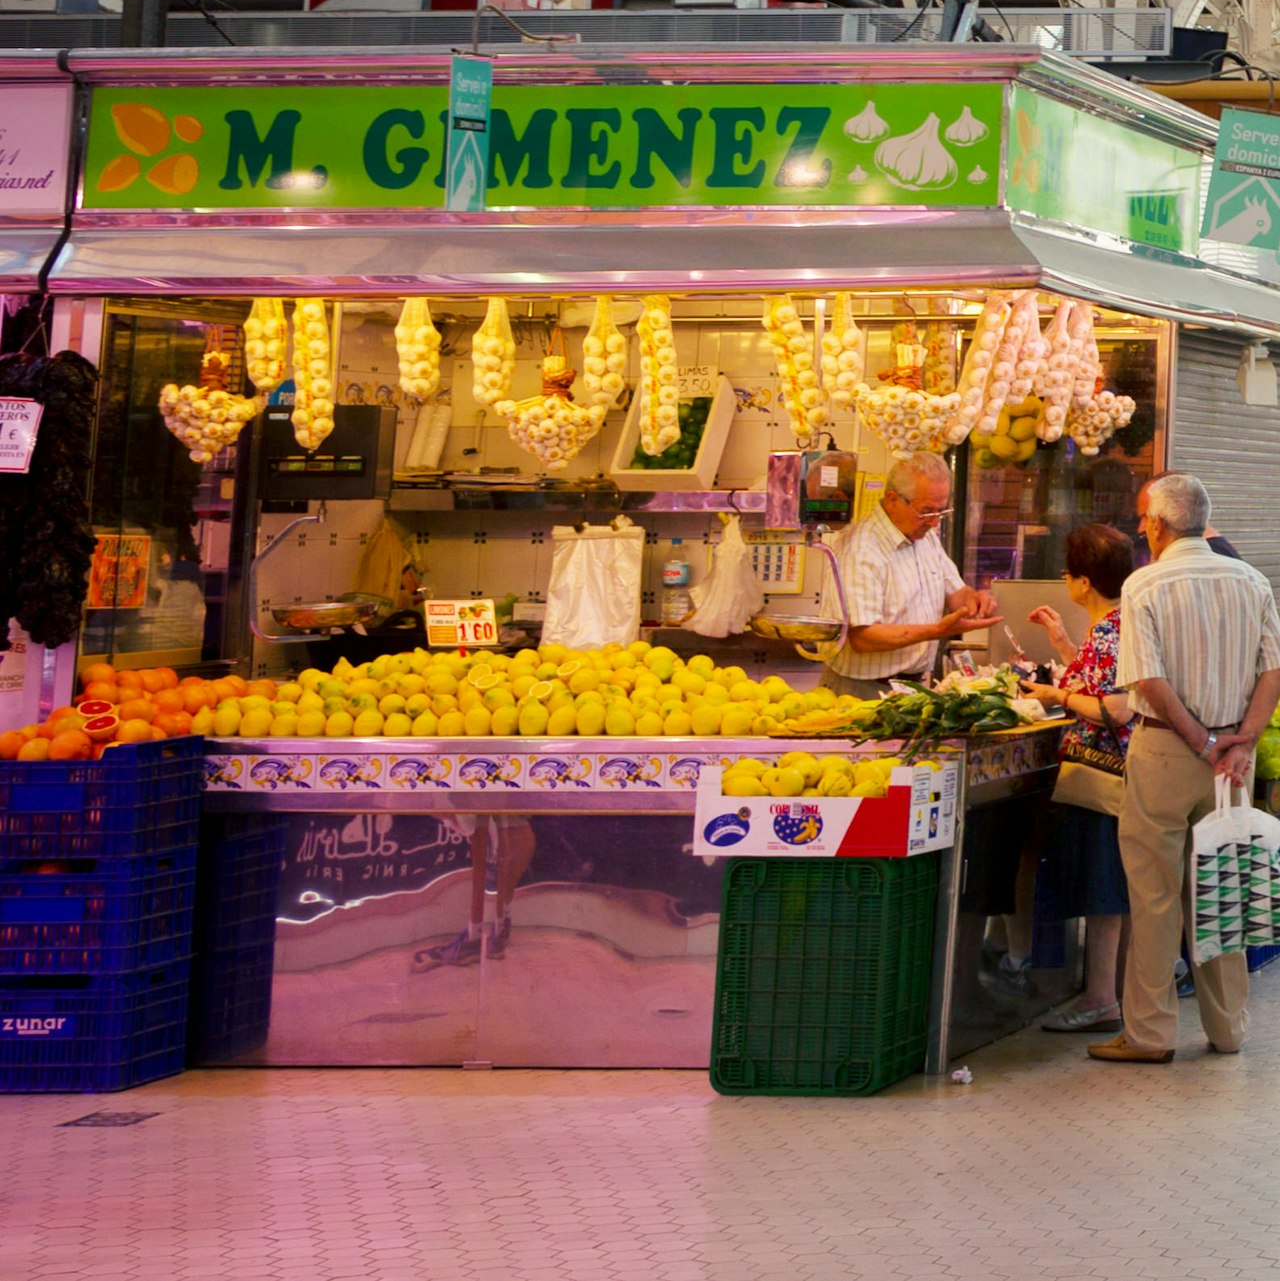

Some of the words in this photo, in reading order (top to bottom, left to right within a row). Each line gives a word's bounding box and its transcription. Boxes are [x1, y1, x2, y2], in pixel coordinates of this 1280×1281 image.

[362, 106, 834, 190] GMENEZ
[0, 169, 55, 189] ias.net
[678, 366, 709, 377] LIMAS
[2, 1017, 66, 1030] zunar
